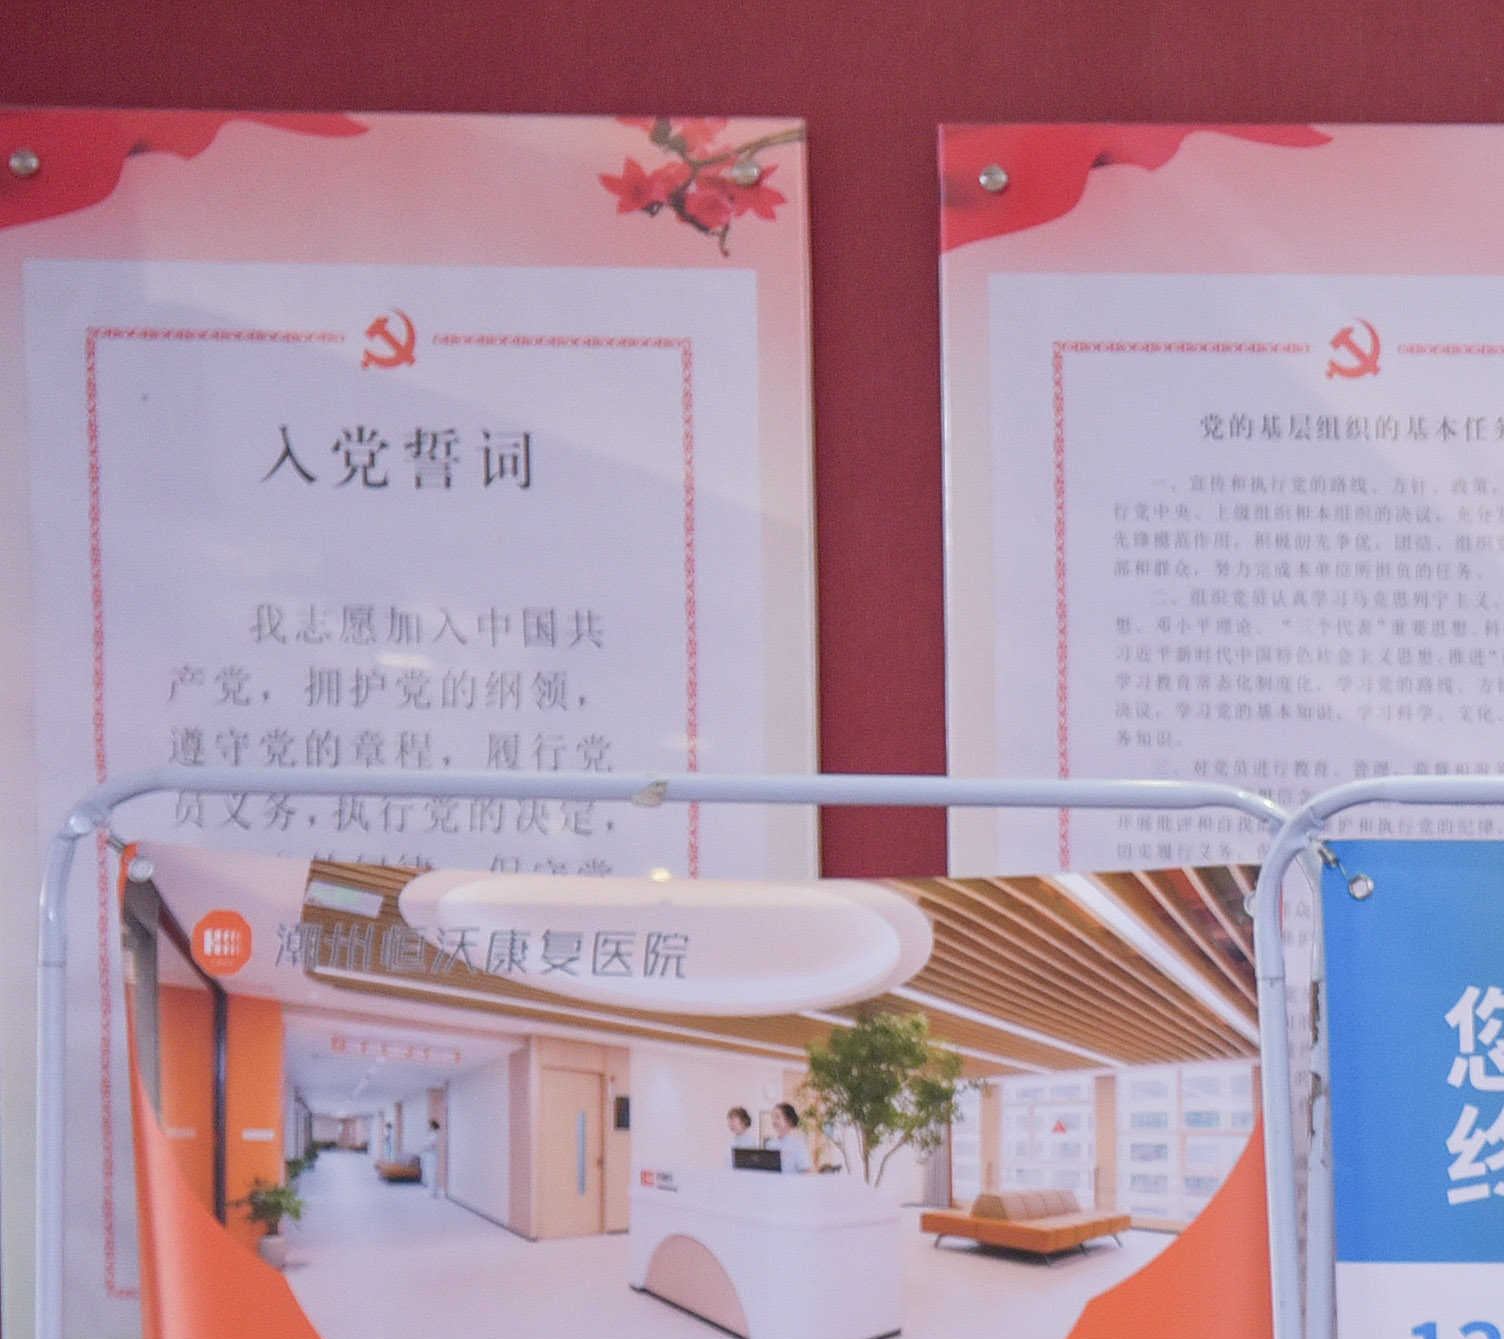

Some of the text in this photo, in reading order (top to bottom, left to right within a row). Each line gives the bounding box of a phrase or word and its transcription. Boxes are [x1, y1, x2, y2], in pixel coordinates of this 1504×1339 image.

[260, 425, 536, 491] 入党誓词
[250, 603, 604, 648] 我志愿加入中国共
[275, 922, 690, 979] 潮州恒沃康复医院
